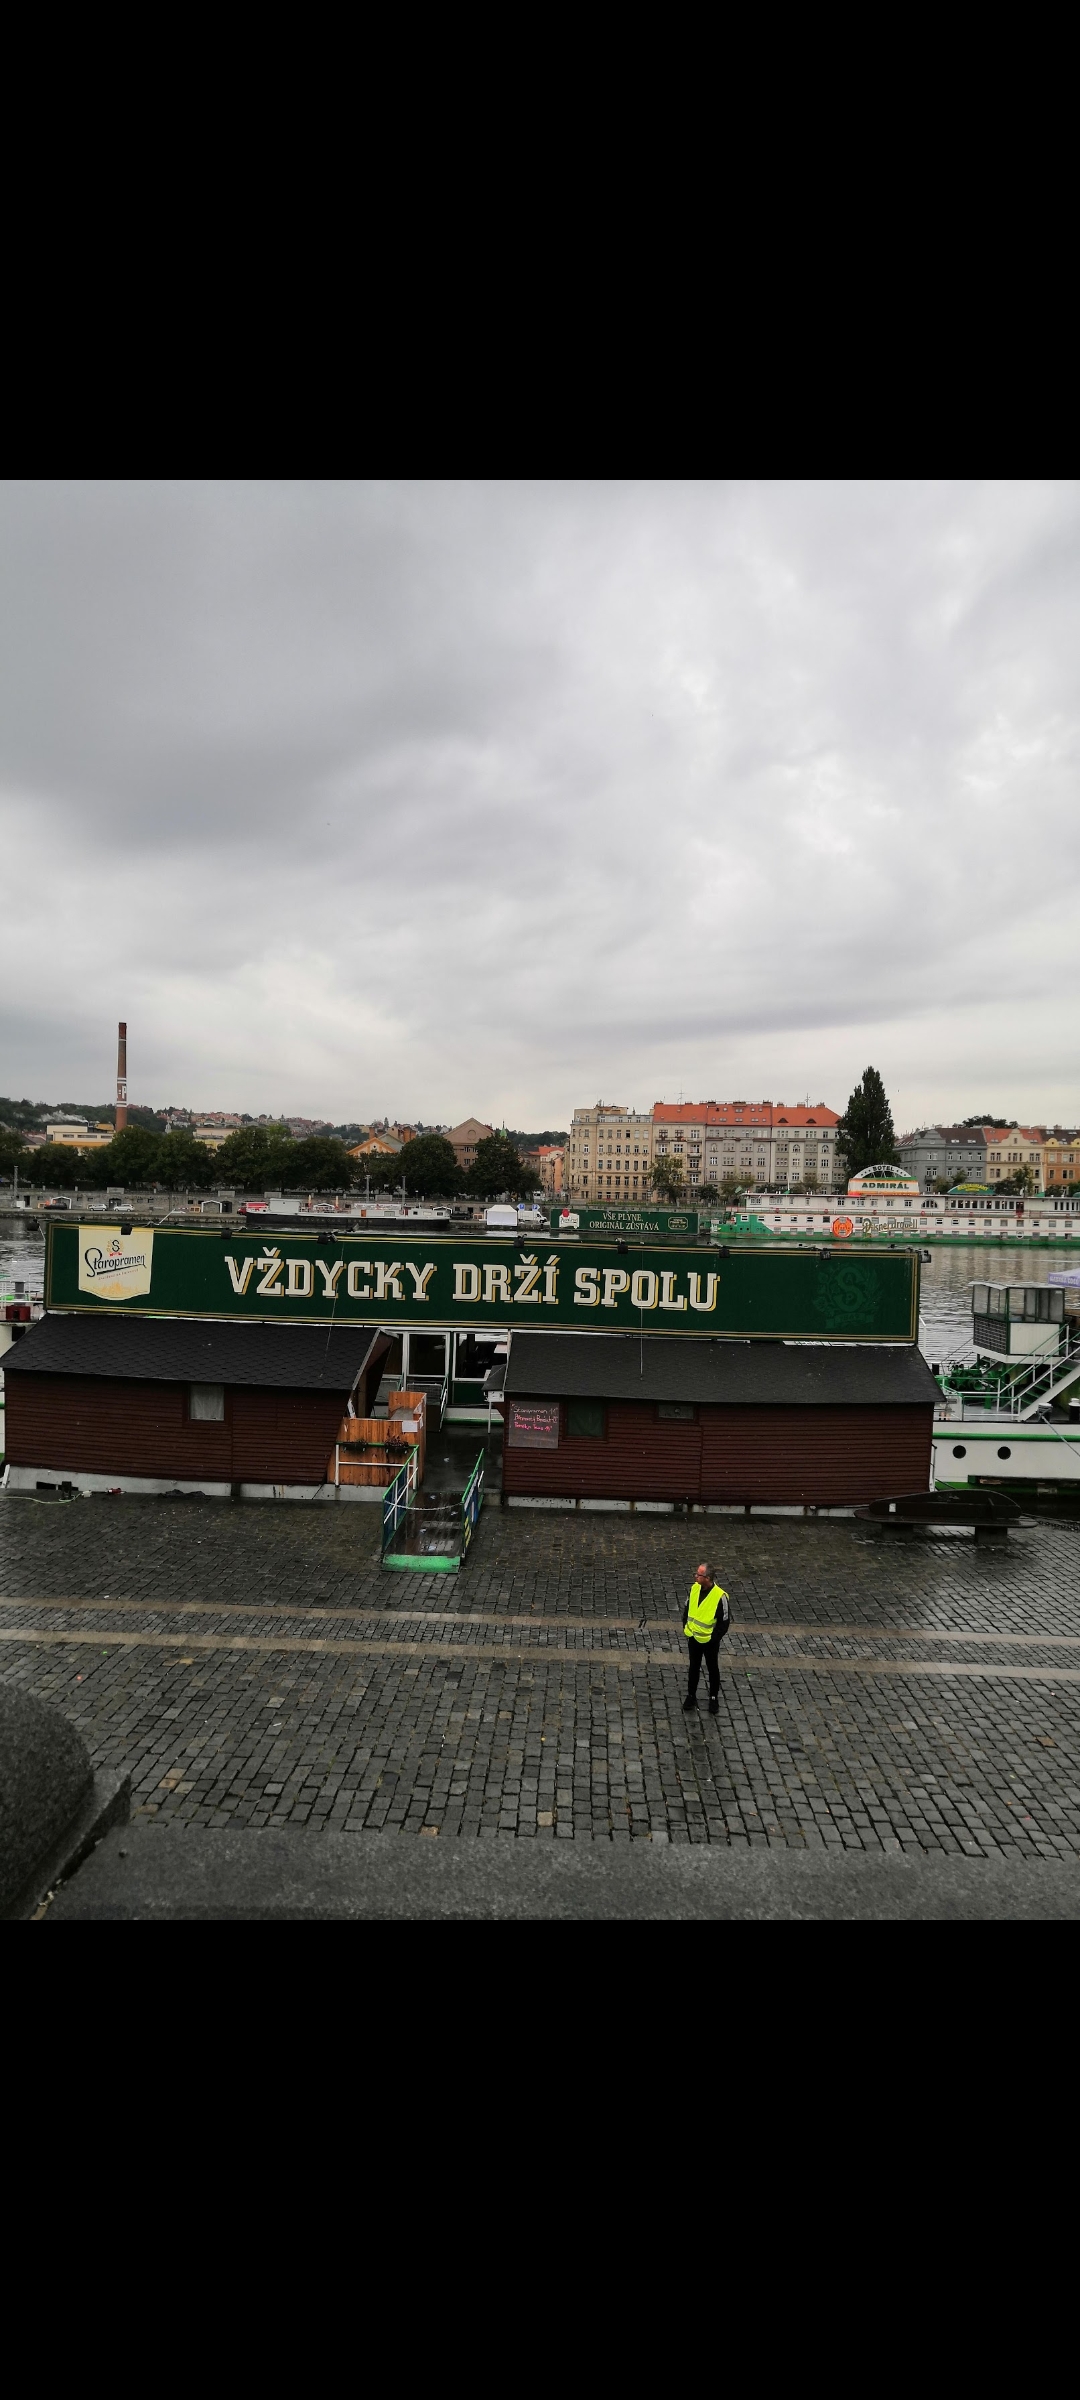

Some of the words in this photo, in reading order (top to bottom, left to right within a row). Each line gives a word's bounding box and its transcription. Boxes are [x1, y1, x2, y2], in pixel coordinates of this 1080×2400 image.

[862, 1181, 909, 1189] ADMIRÁL
[602, 1211, 617, 1220] VŠE
[589, 1220, 624, 1230] ORIGINÁL
[626, 1221, 660, 1231] ZŮSTÁVÁ
[84, 1247, 147, 1277] Staropramen
[224, 1247, 437, 1301] VŽDYCKY
[452, 1254, 561, 1304] DRŽÍ
[573, 1268, 721, 1312] SPOLU
